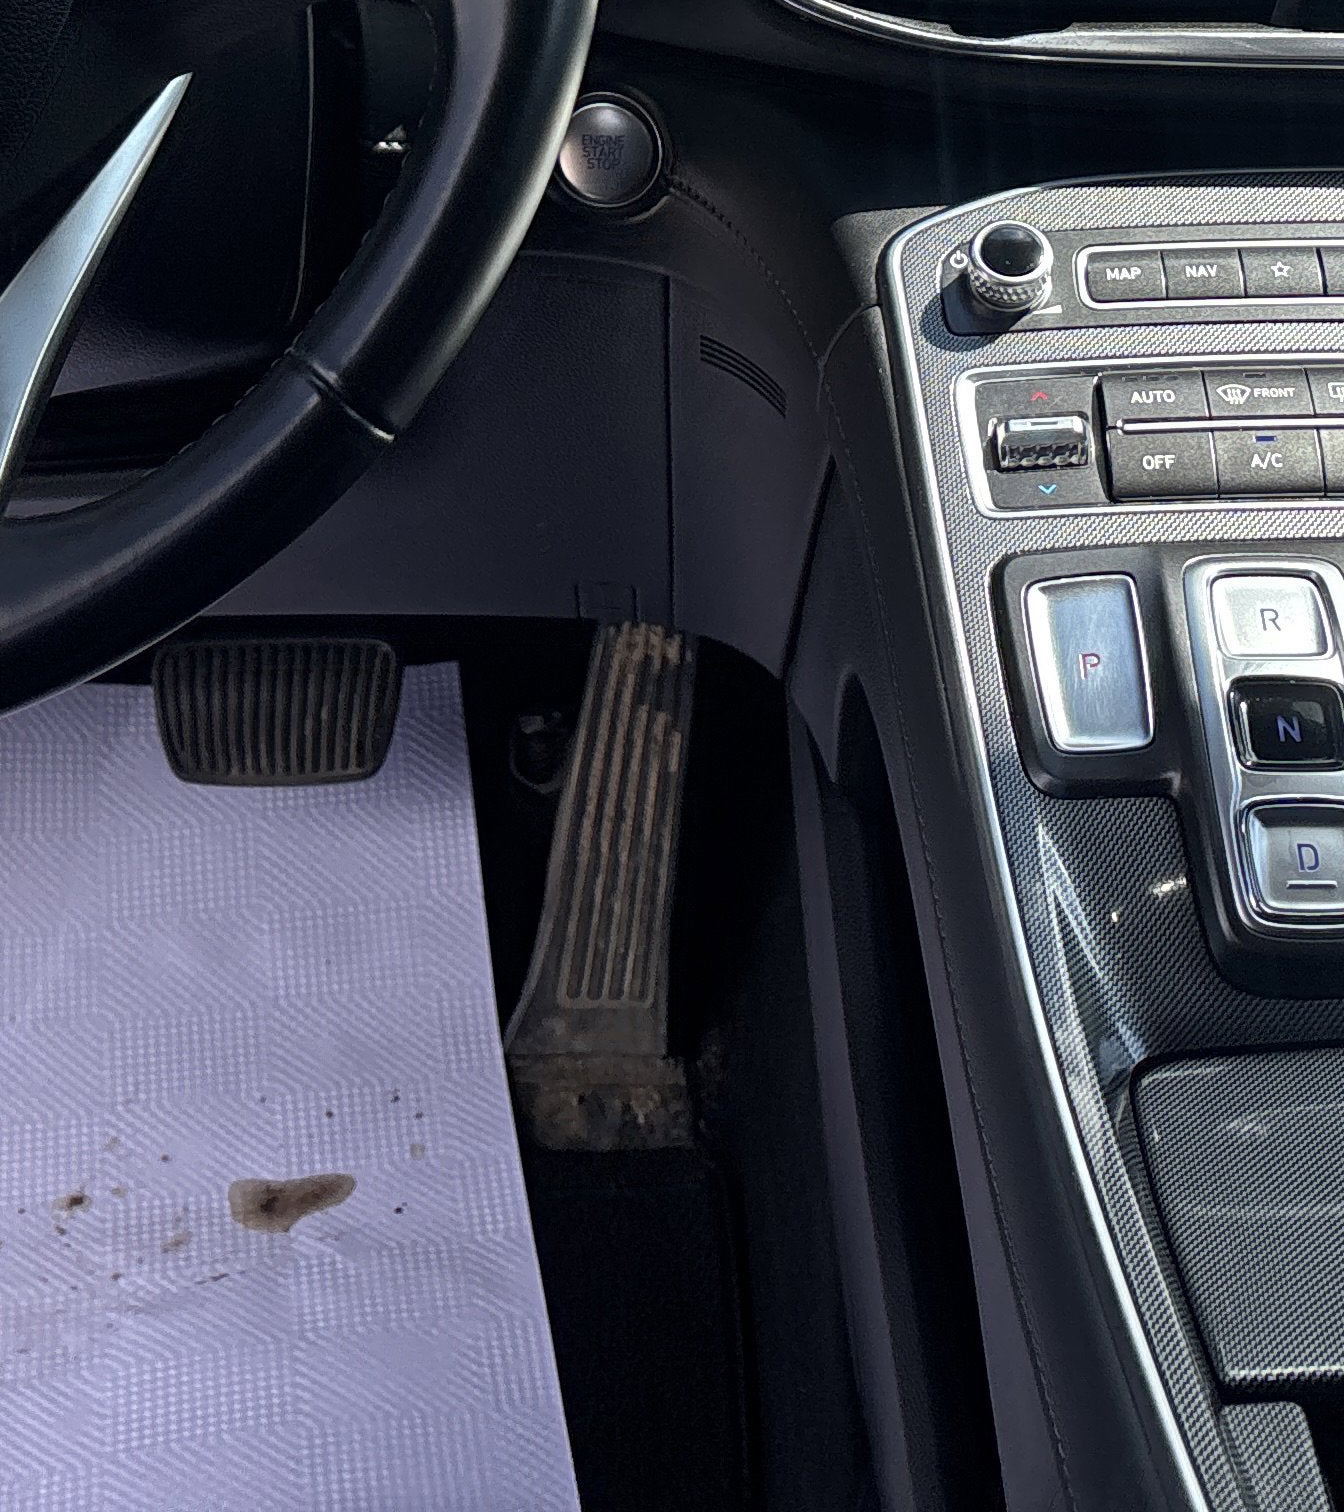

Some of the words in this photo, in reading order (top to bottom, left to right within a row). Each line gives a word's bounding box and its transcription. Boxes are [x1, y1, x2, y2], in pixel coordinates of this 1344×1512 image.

[582, 134, 626, 146] ENGINE
[582, 145, 624, 158] START
[587, 157, 622, 170] STOP
[1105, 266, 1142, 281] MAP
[1184, 263, 1218, 278] NAV
[1130, 389, 1176, 404] AUTO
[1253, 387, 1296, 399] FRONT
[1142, 454, 1176, 470] OFF
[1250, 451, 1284, 470] A/C
[1259, 608, 1281, 631] R
[1078, 652, 1101, 680] P
[1276, 715, 1302, 743] N
[1297, 843, 1320, 872] D
